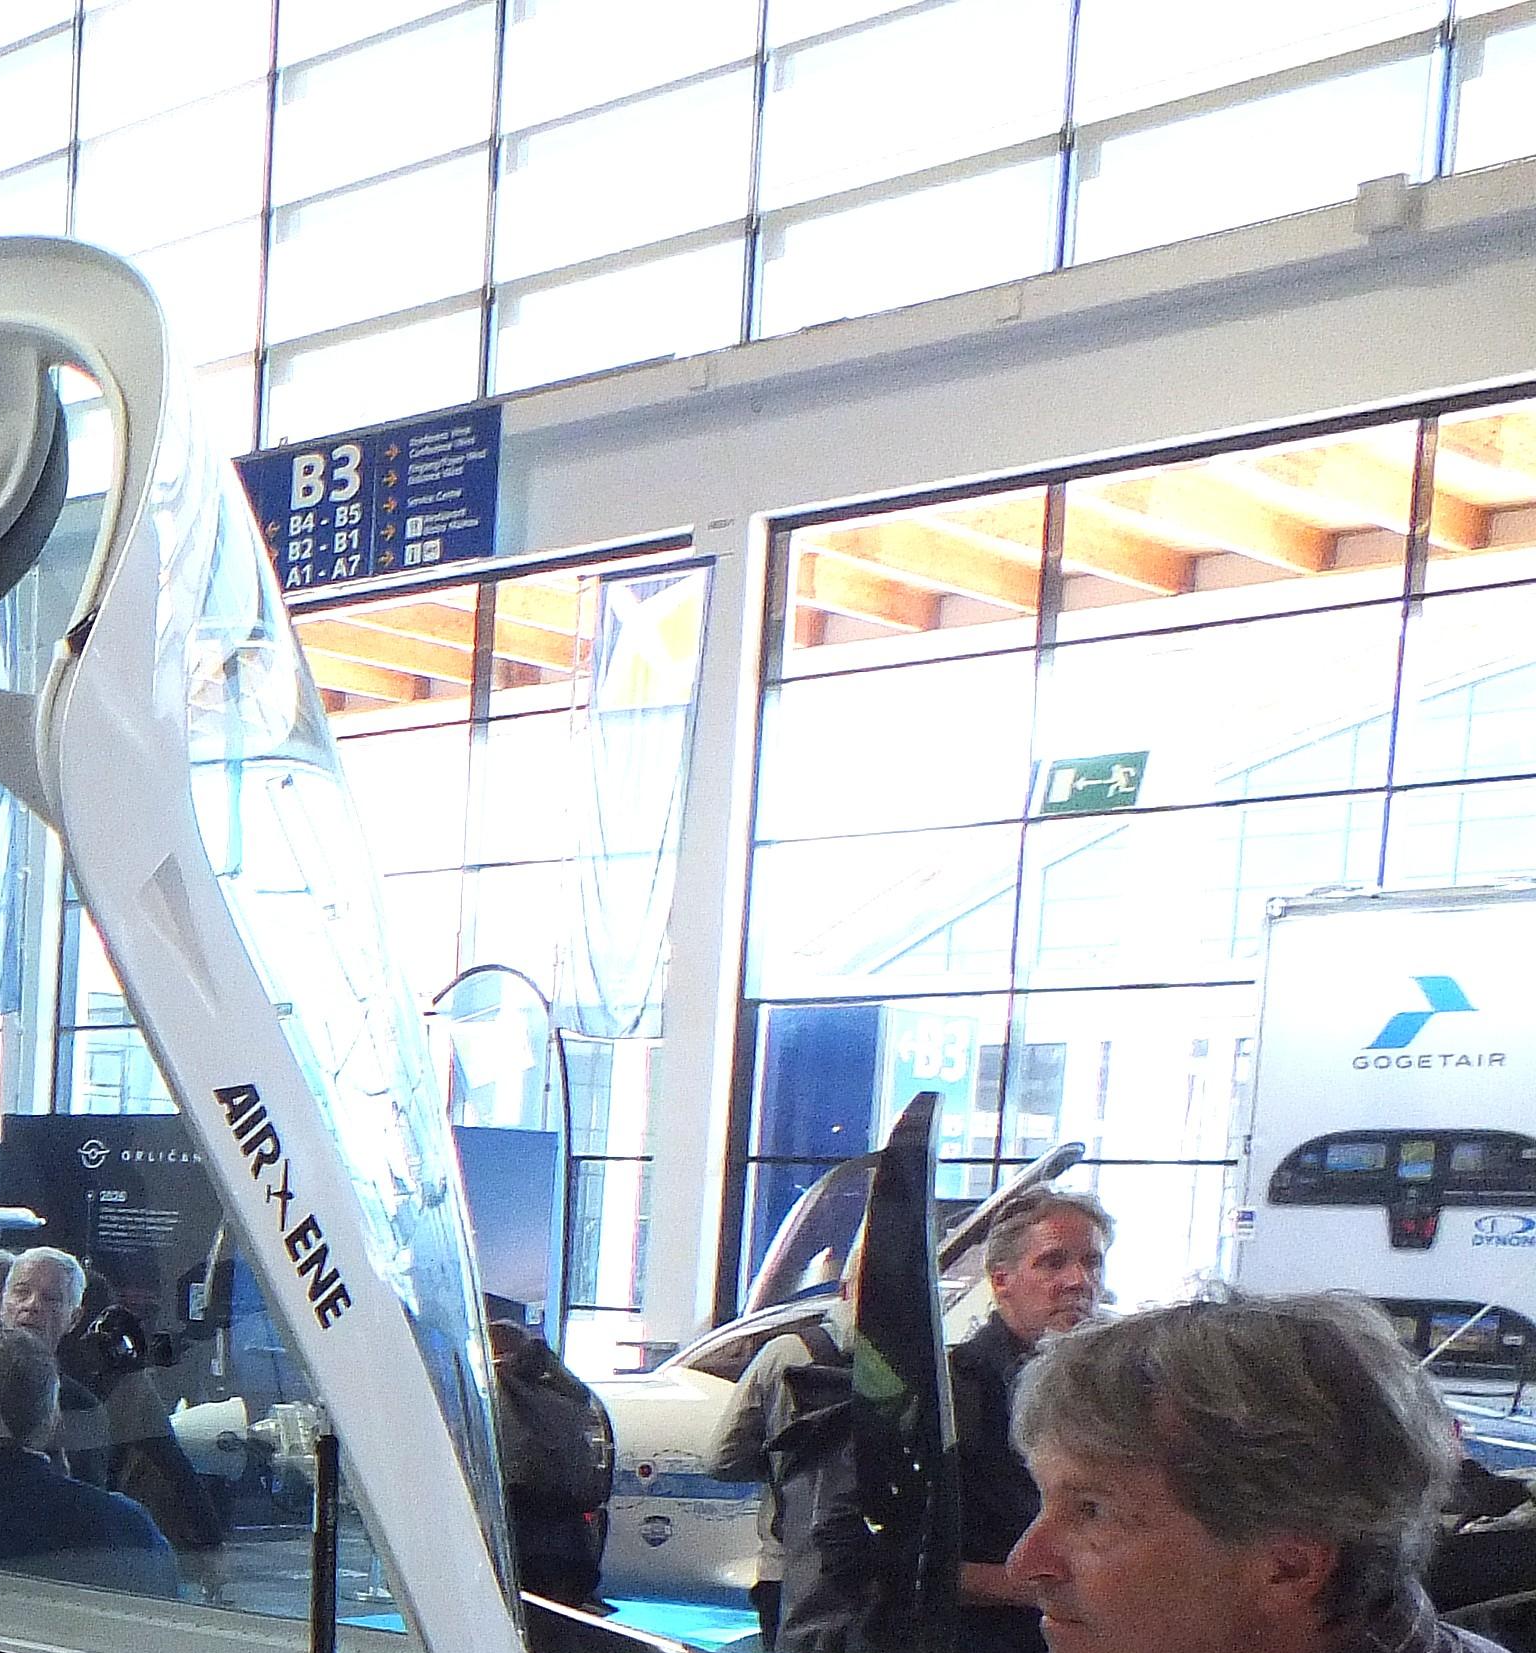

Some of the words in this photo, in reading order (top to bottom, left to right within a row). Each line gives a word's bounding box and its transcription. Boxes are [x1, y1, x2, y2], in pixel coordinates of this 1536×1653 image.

[290, 444, 362, 511] B3
[288, 514, 315, 538] B4
[334, 502, 362, 527] B5
[288, 538, 314, 562] B2
[334, 530, 360, 553] B1
[285, 563, 314, 588] A1
[330, 554, 361, 581] A7
[1352, 1053, 1508, 1070] GOGETAIR
